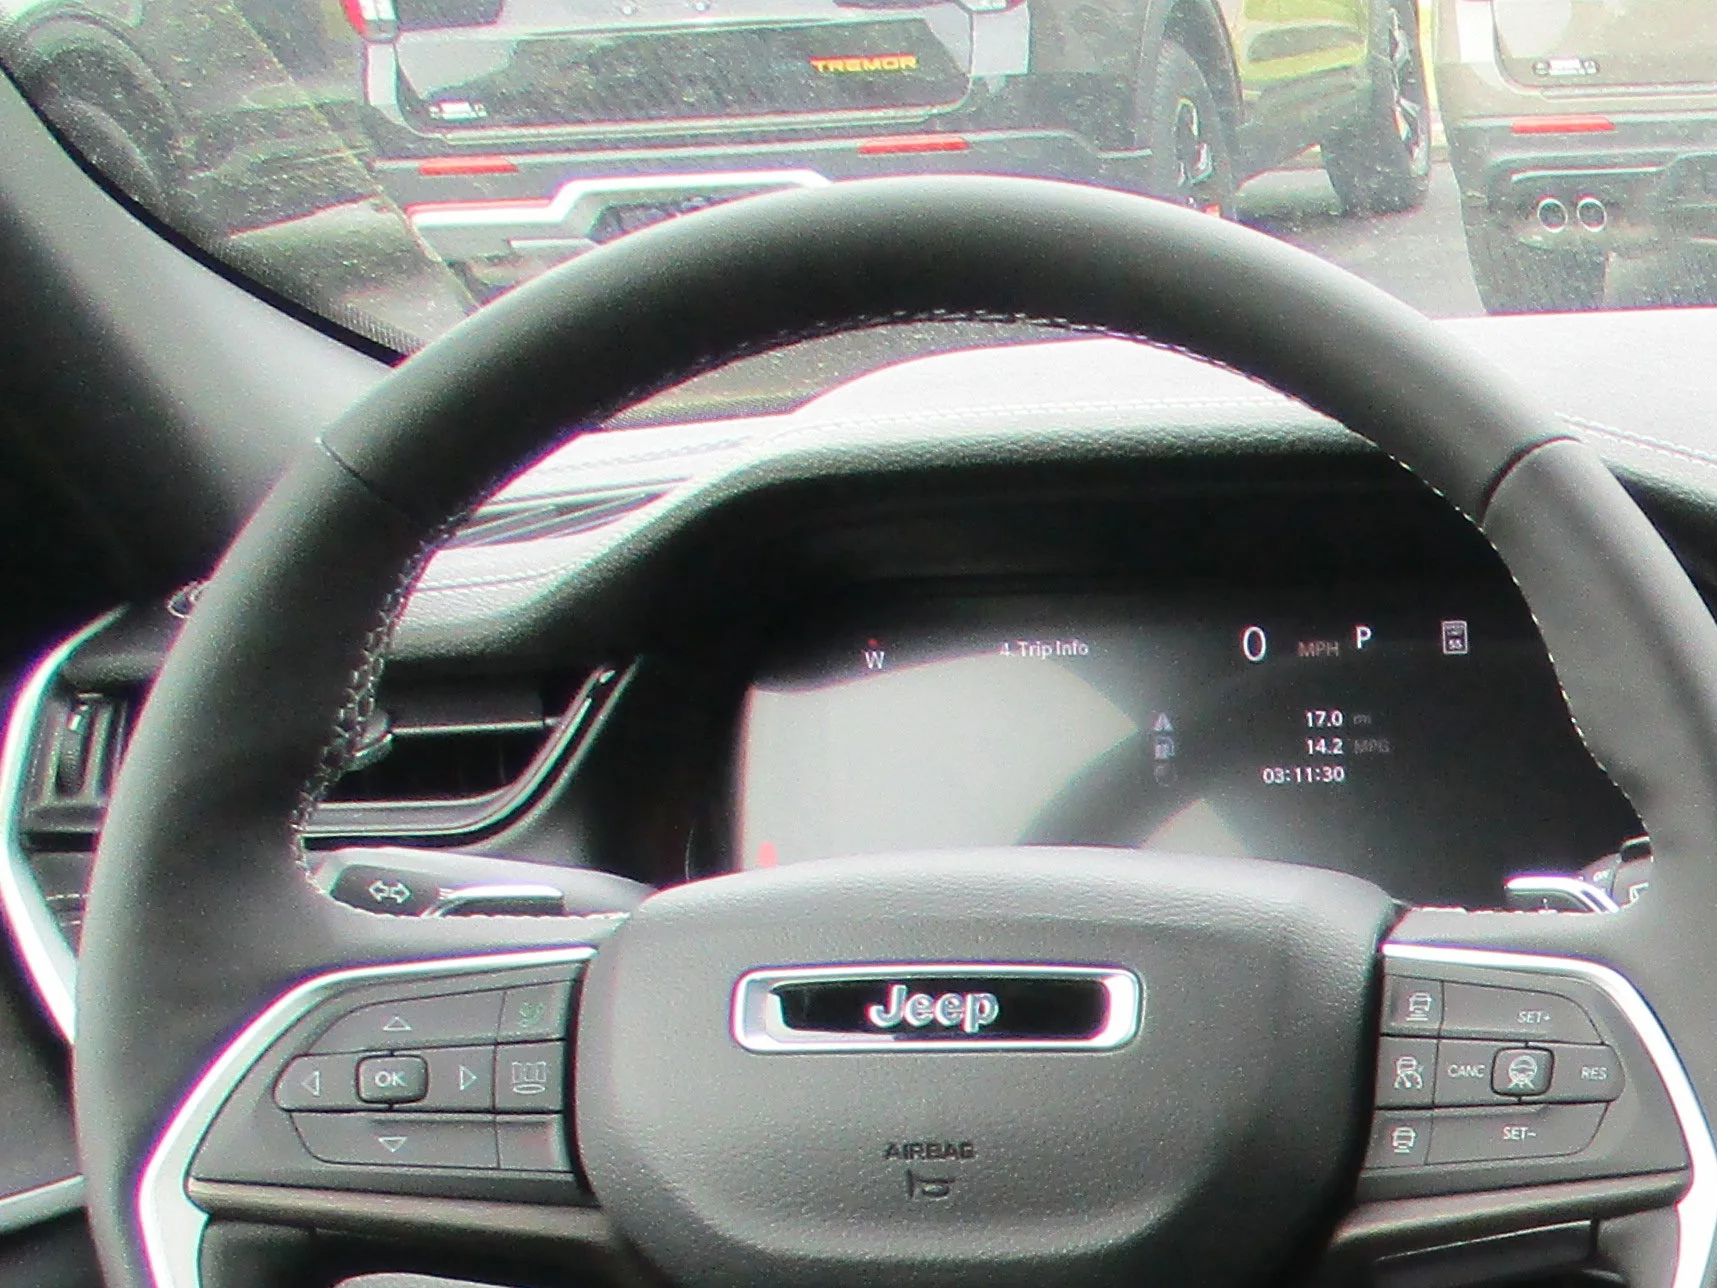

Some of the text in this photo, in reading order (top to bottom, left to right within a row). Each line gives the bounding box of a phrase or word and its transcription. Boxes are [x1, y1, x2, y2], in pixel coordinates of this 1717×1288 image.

[808, 54, 919, 73] TREMOR
[1242, 626, 1340, 663] 0 MPH
[1354, 624, 1372, 649] P
[1018, 641, 1053, 660] Trip
[1055, 639, 1090, 657] Info
[864, 651, 885, 670] W
[1306, 710, 1343, 727] 17.0
[1306, 738, 1344, 755] 14.2
[1263, 765, 1346, 784] 03:11:30
[868, 984, 999, 1034] Jeep
[1517, 1010, 1551, 1024] SET+
[375, 1070, 408, 1087] OK
[1447, 1064, 1486, 1078] CANC
[1580, 1066, 1608, 1080] RES
[884, 1142, 976, 1160] AIRBAG
